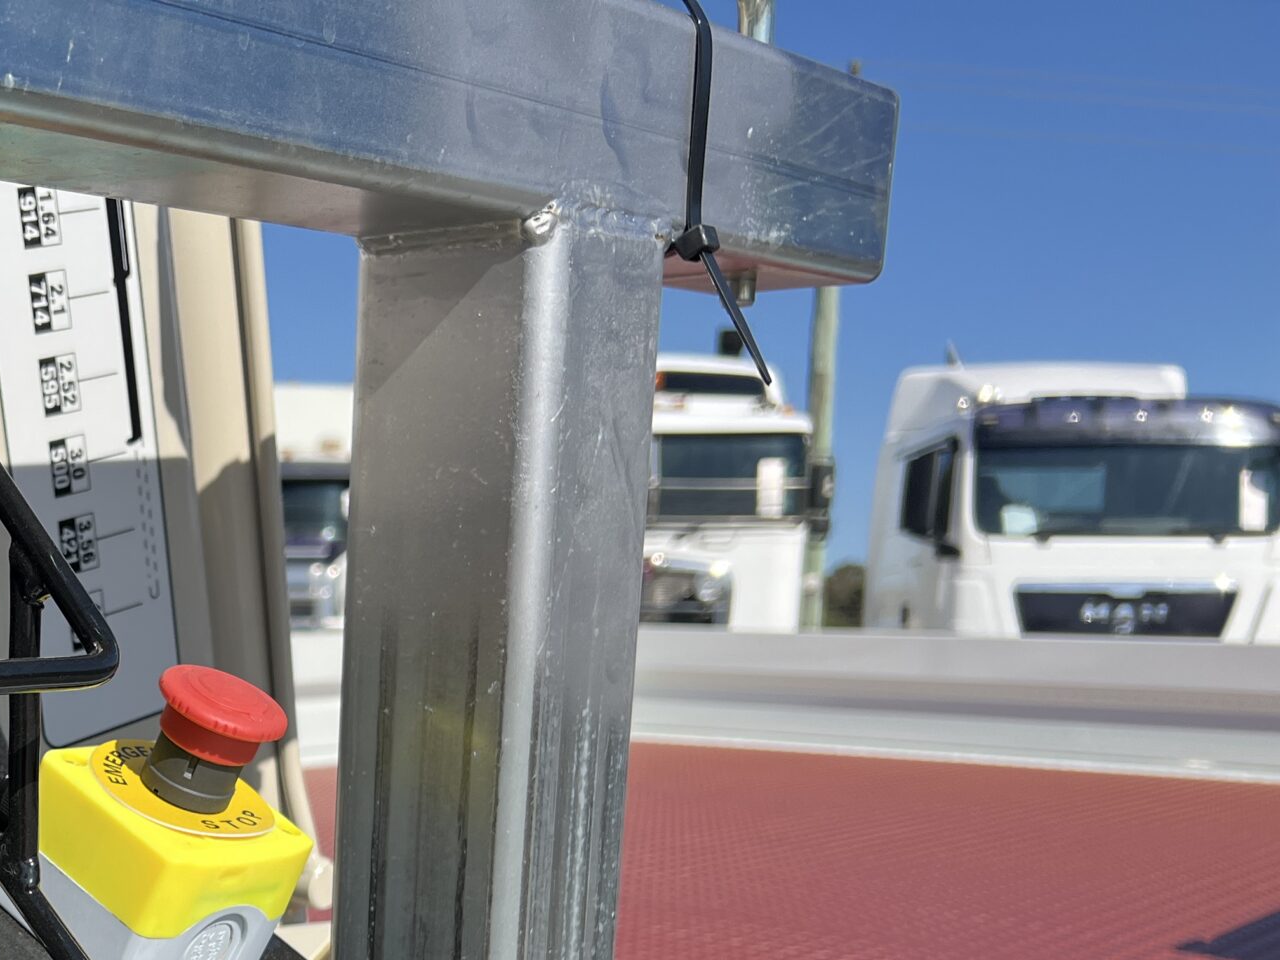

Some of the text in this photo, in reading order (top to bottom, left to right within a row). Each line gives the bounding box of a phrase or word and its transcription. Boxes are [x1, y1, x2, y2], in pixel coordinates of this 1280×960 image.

[19, 191, 40, 242] 914
[30, 278, 51, 326] 714
[50, 284, 66, 316] 2.1
[41, 364, 62, 410] 595
[60, 360, 77, 408] 2.52
[50, 445, 70, 490] 500
[102, 745, 263, 830] EMERGE STOP
